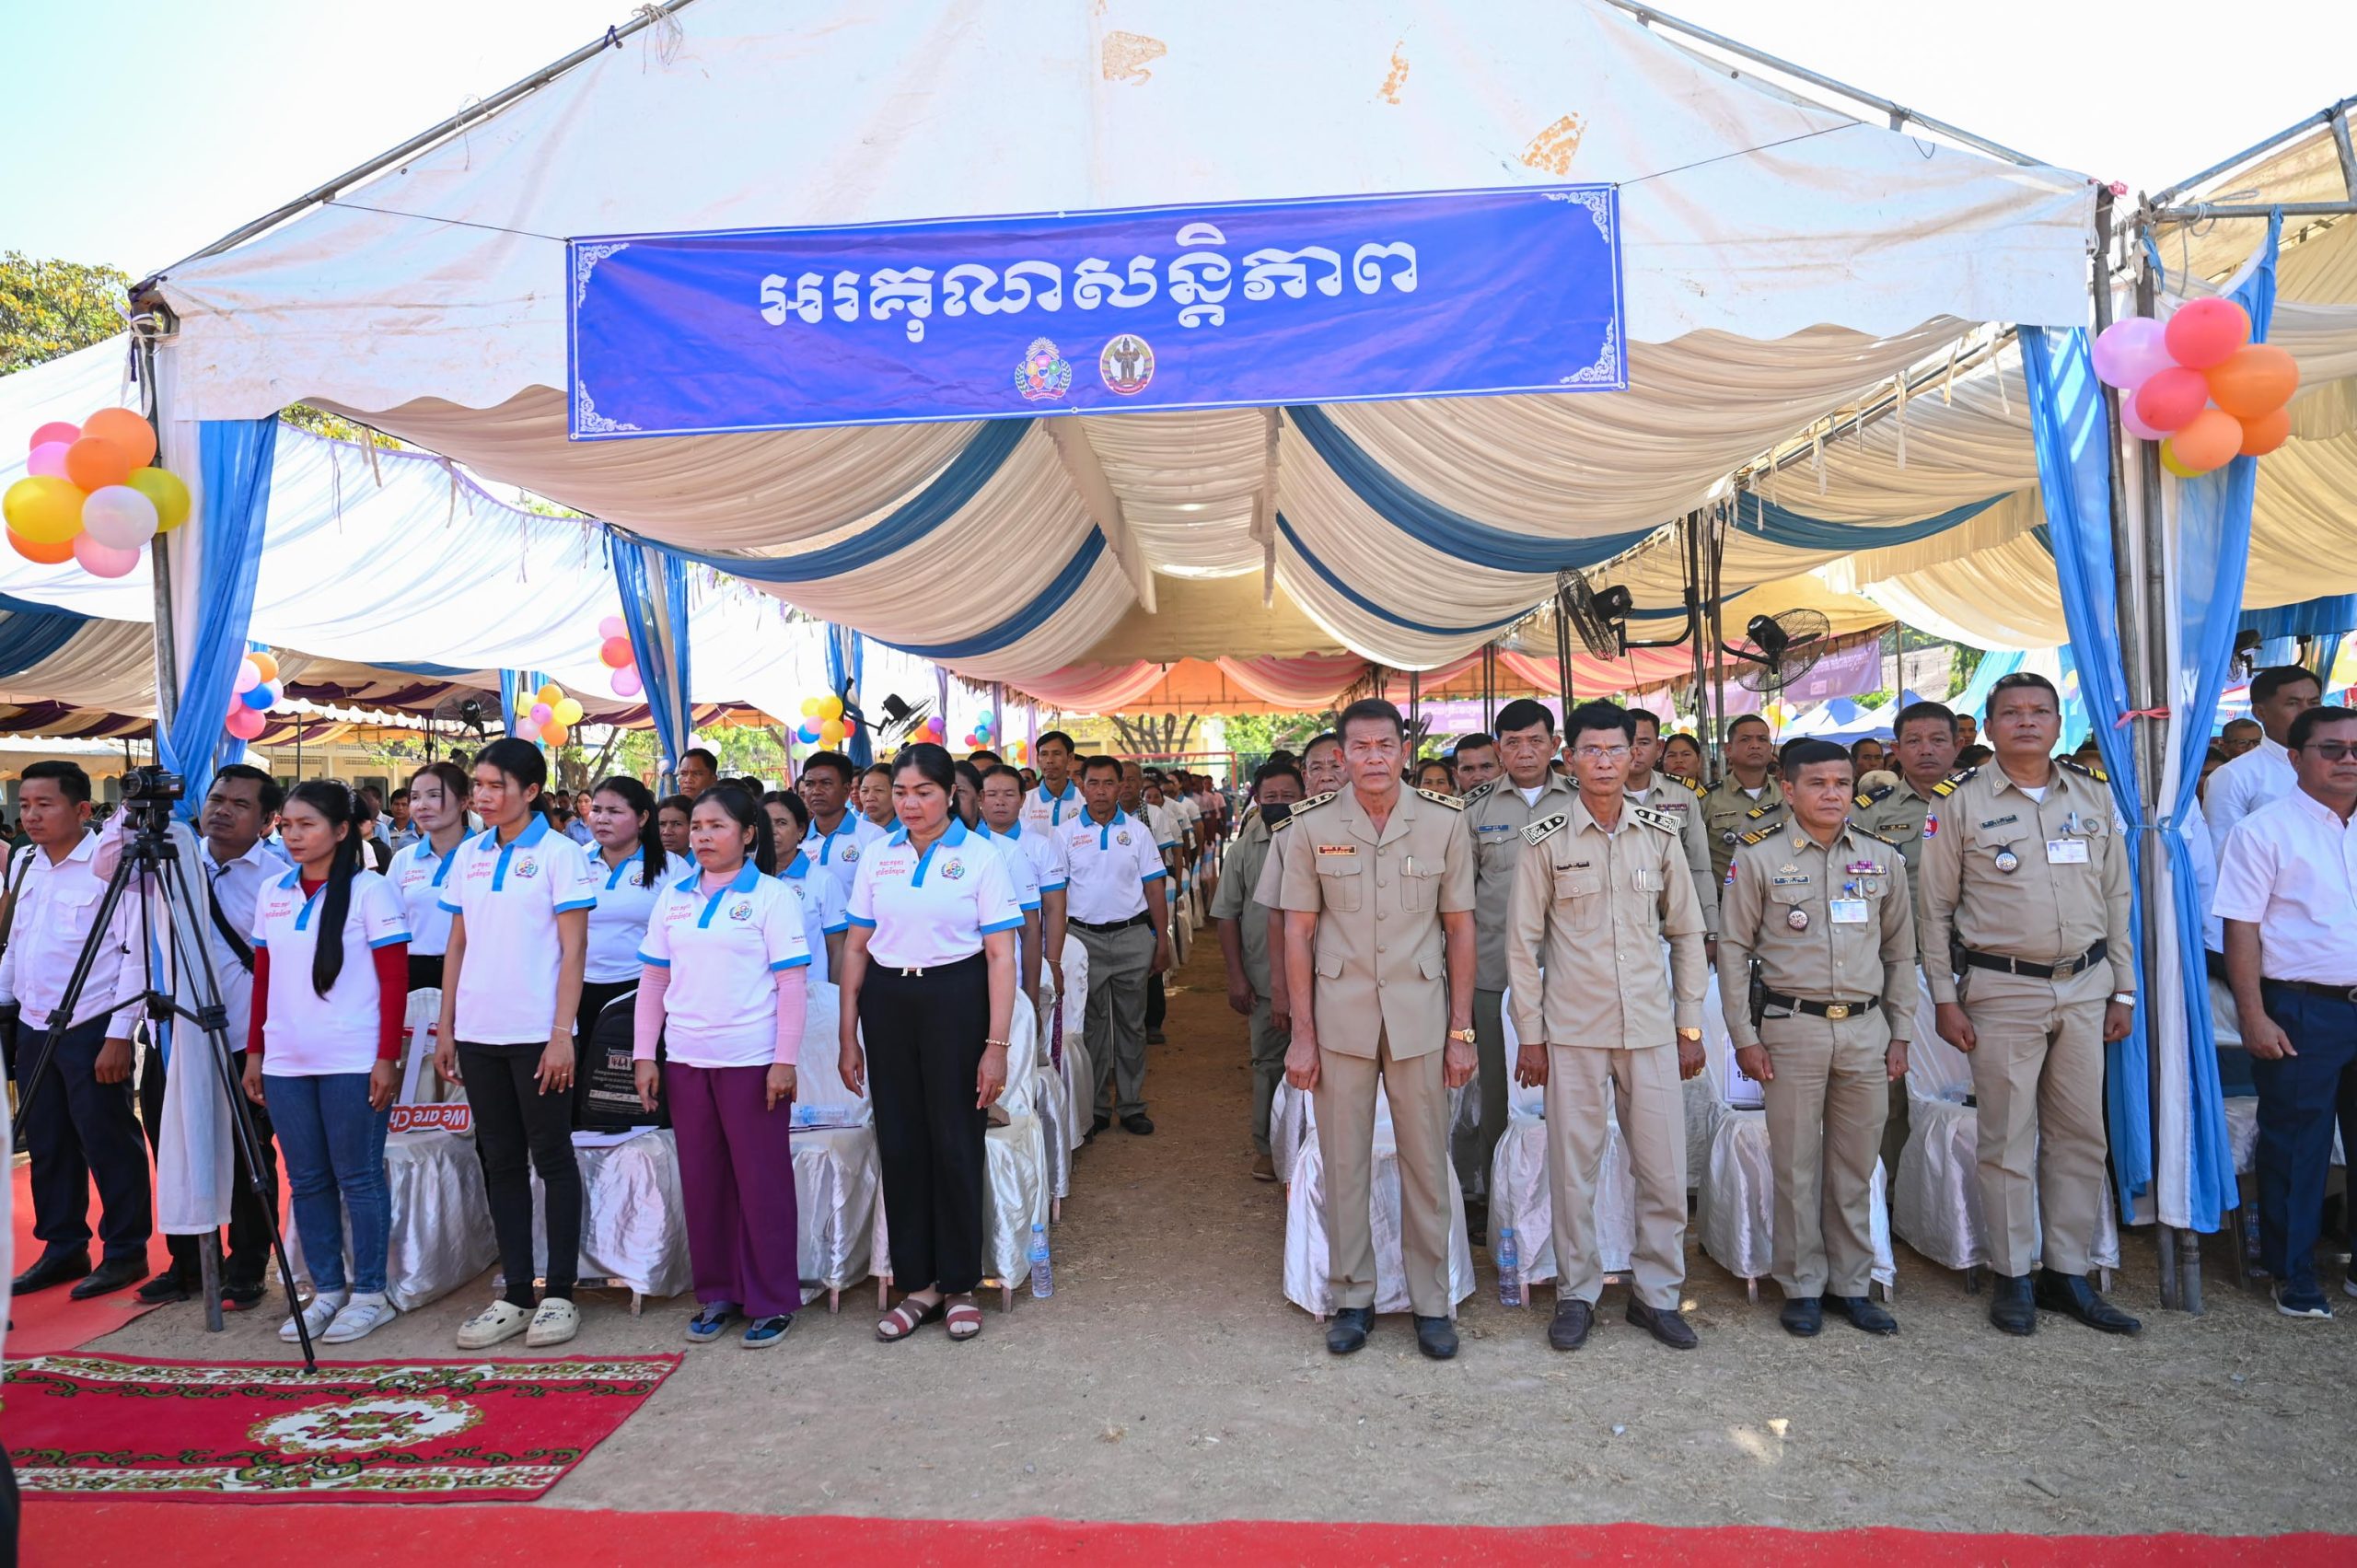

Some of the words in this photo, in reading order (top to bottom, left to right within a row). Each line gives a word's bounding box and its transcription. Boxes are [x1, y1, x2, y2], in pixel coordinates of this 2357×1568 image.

[389, 1109, 411, 1129] Ch
[413, 1109, 440, 1123] are
[443, 1109, 466, 1126] We
